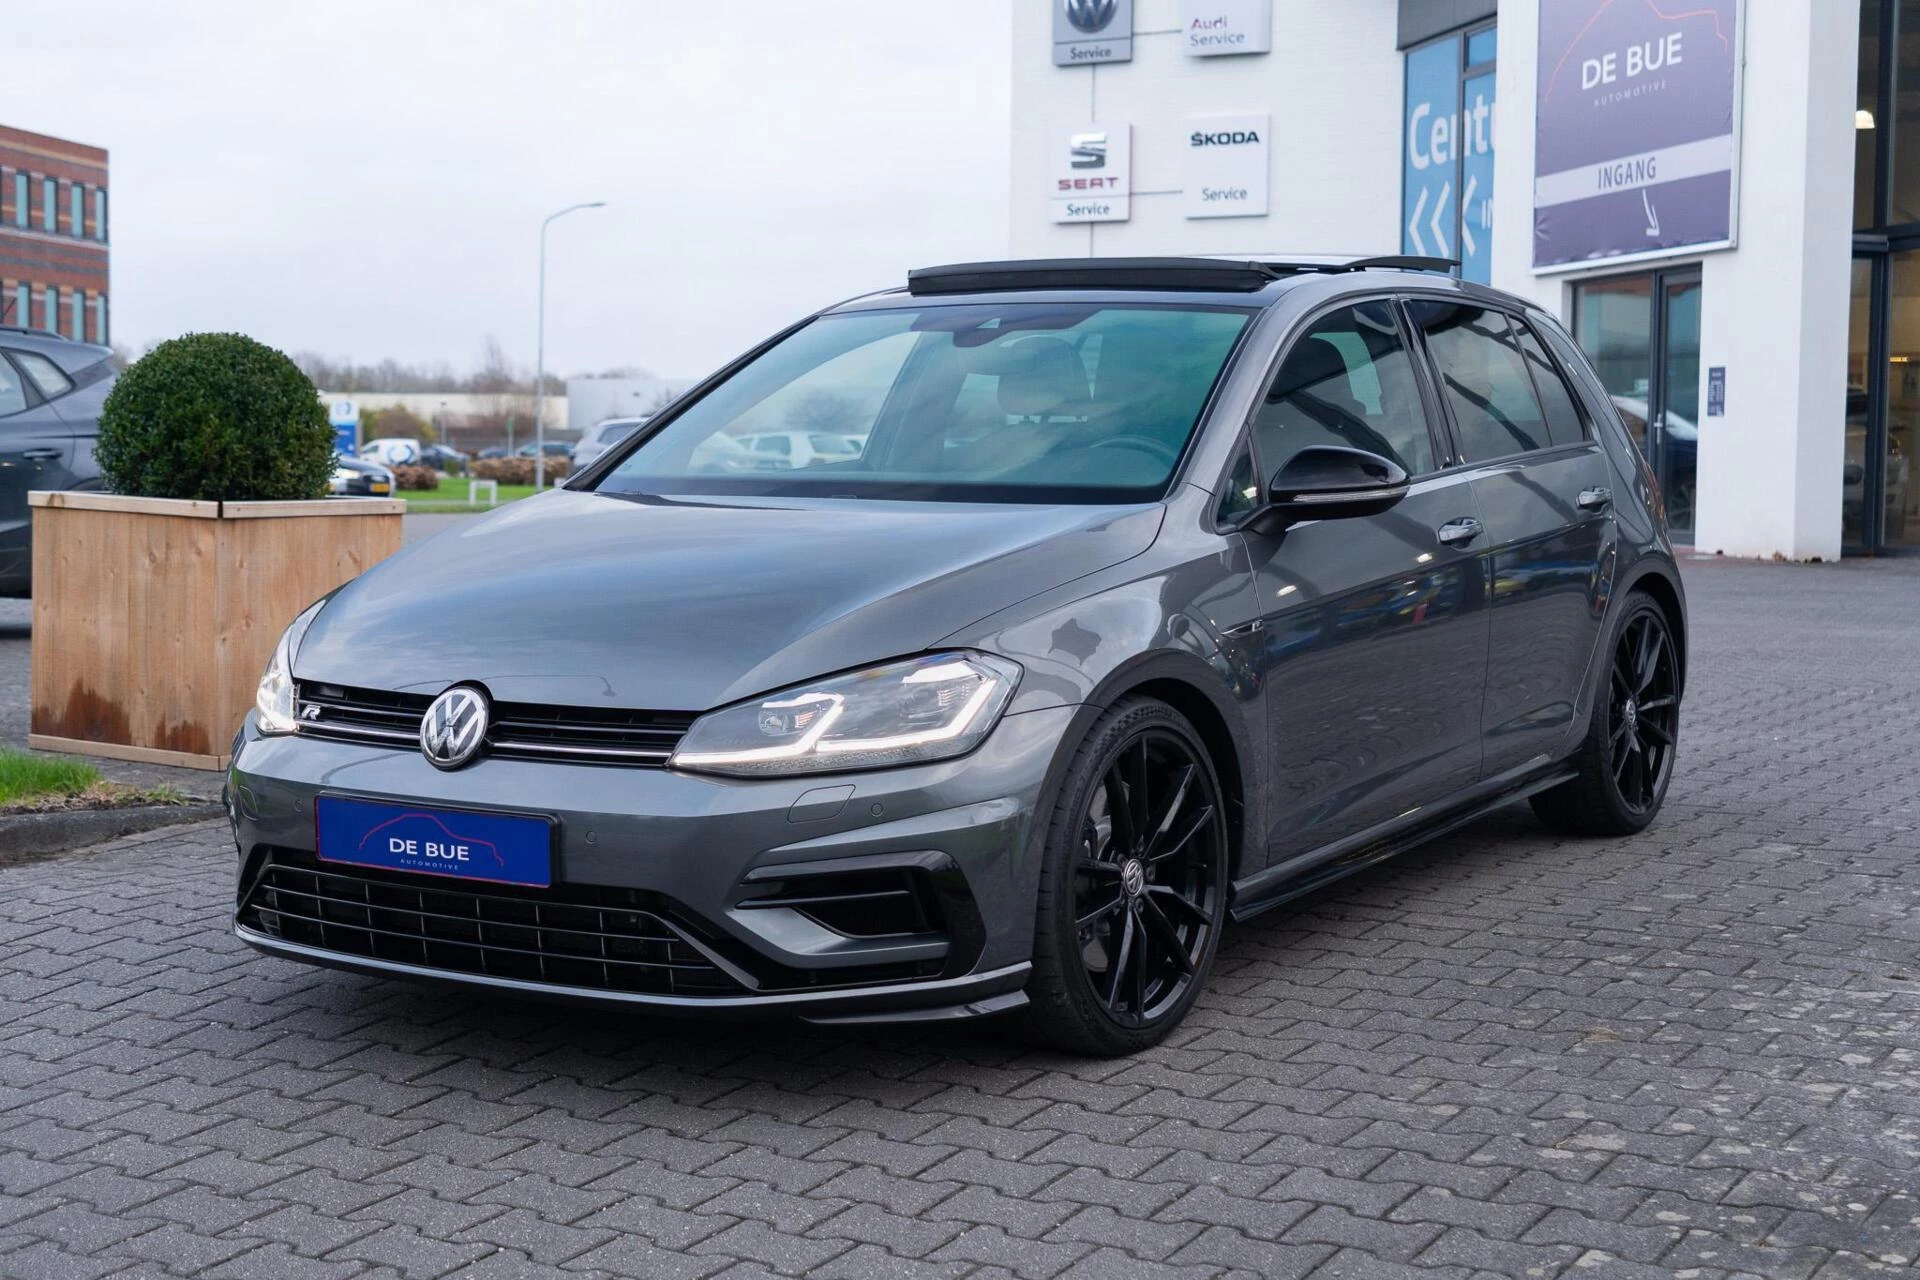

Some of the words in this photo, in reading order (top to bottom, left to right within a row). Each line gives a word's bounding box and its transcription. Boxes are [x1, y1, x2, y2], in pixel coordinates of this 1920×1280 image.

[1191, 16, 1228, 30] Audi
[1190, 33, 1245, 46] Service
[1070, 47, 1112, 60] Service
[1581, 51, 1617, 90] DE
[1626, 32, 1683, 77] BUE
[1593, 79, 1667, 107] AUTOMOTIVE
[1190, 131, 1260, 147] ŠKODA
[1597, 157, 1657, 190] INGANG
[1058, 177, 1118, 190] SEAT
[1202, 188, 1248, 201] Service
[1067, 204, 1110, 216] Service
[389, 838, 417, 855] DE
[425, 842, 470, 861] BUE
[400, 858, 459, 870] AUTOMOTIVE
